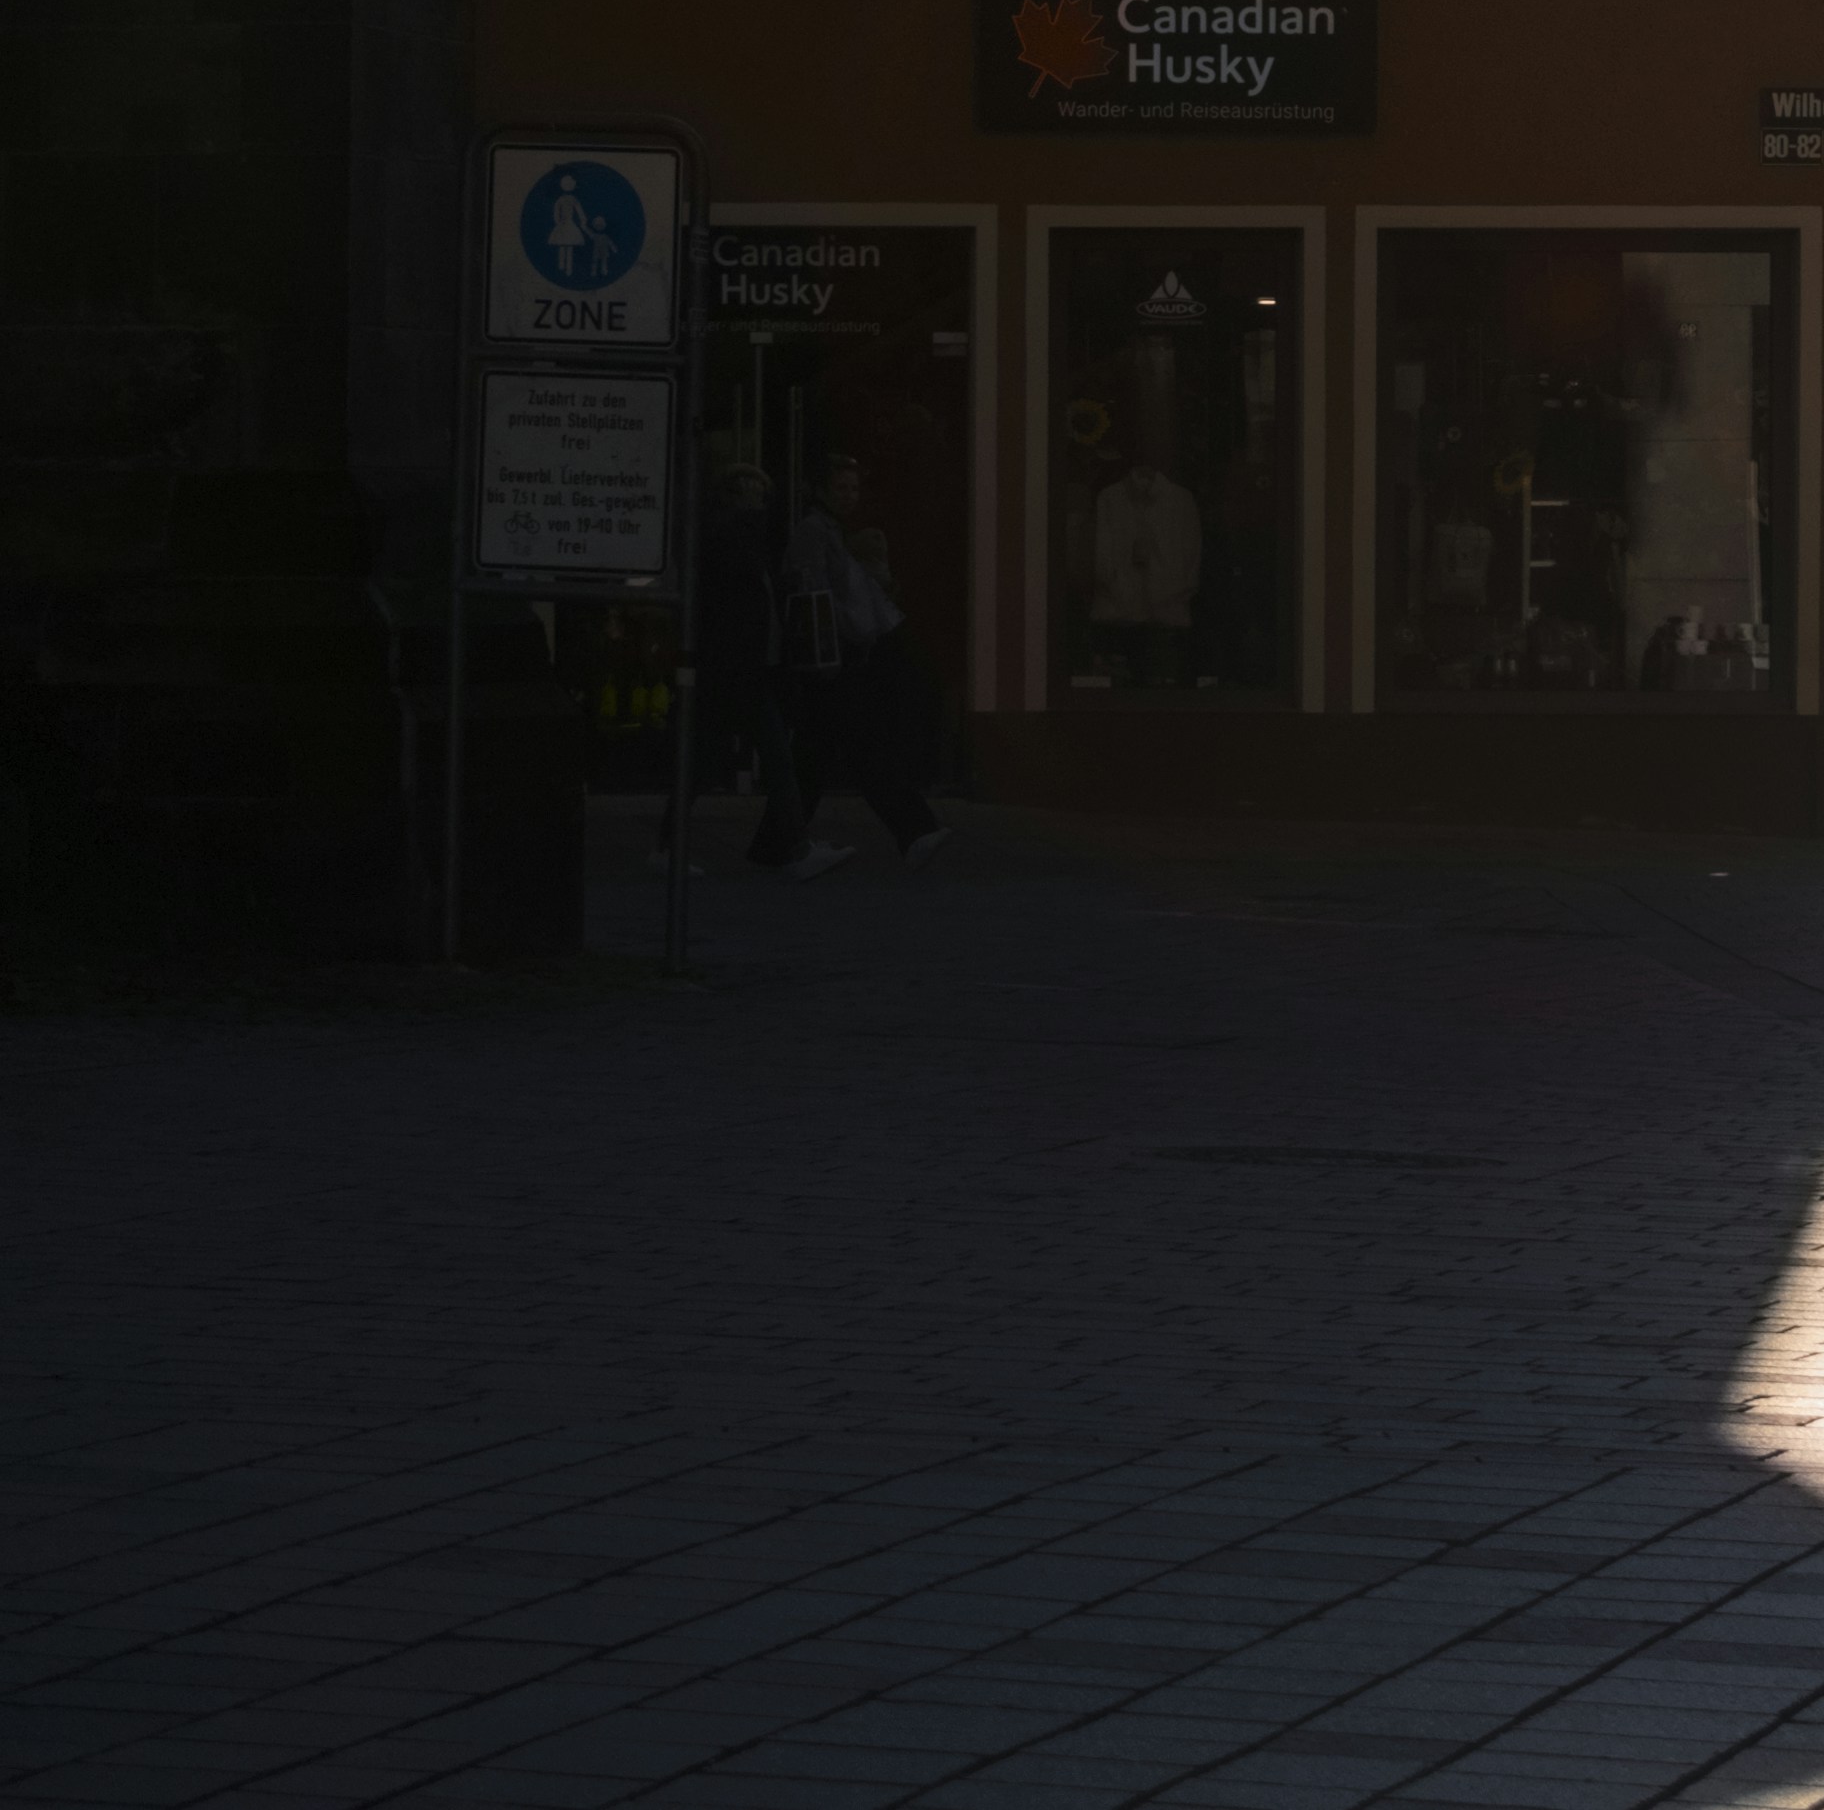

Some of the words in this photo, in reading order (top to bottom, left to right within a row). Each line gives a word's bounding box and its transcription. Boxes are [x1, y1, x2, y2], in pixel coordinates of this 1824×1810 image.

[1128, 41, 1275, 96] Husky
[1057, 99, 1135, 119] Wander-
[1139, 100, 1175, 119] und
[1180, 101, 1335, 123] Reiseausrüstung
[1763, 133, 1822, 159] 80-82
[712, 234, 881, 268] Canadian
[720, 272, 835, 315] Husky
[533, 298, 628, 332] ZONE
[527, 389, 576, 407] Zufahrt
[581, 394, 597, 408] zu
[602, 392, 627, 408] den
[508, 412, 561, 429] privaten
[567, 412, 644, 432] Stellplätzen
[561, 434, 591, 451] frei
[499, 466, 554, 485] Gewerbl.
[561, 467, 650, 488] Lieferverkehr
[486, 487, 506, 504] bis
[547, 519, 571, 532] von
[618, 518, 641, 535] Uhr
[557, 538, 587, 555] frei
